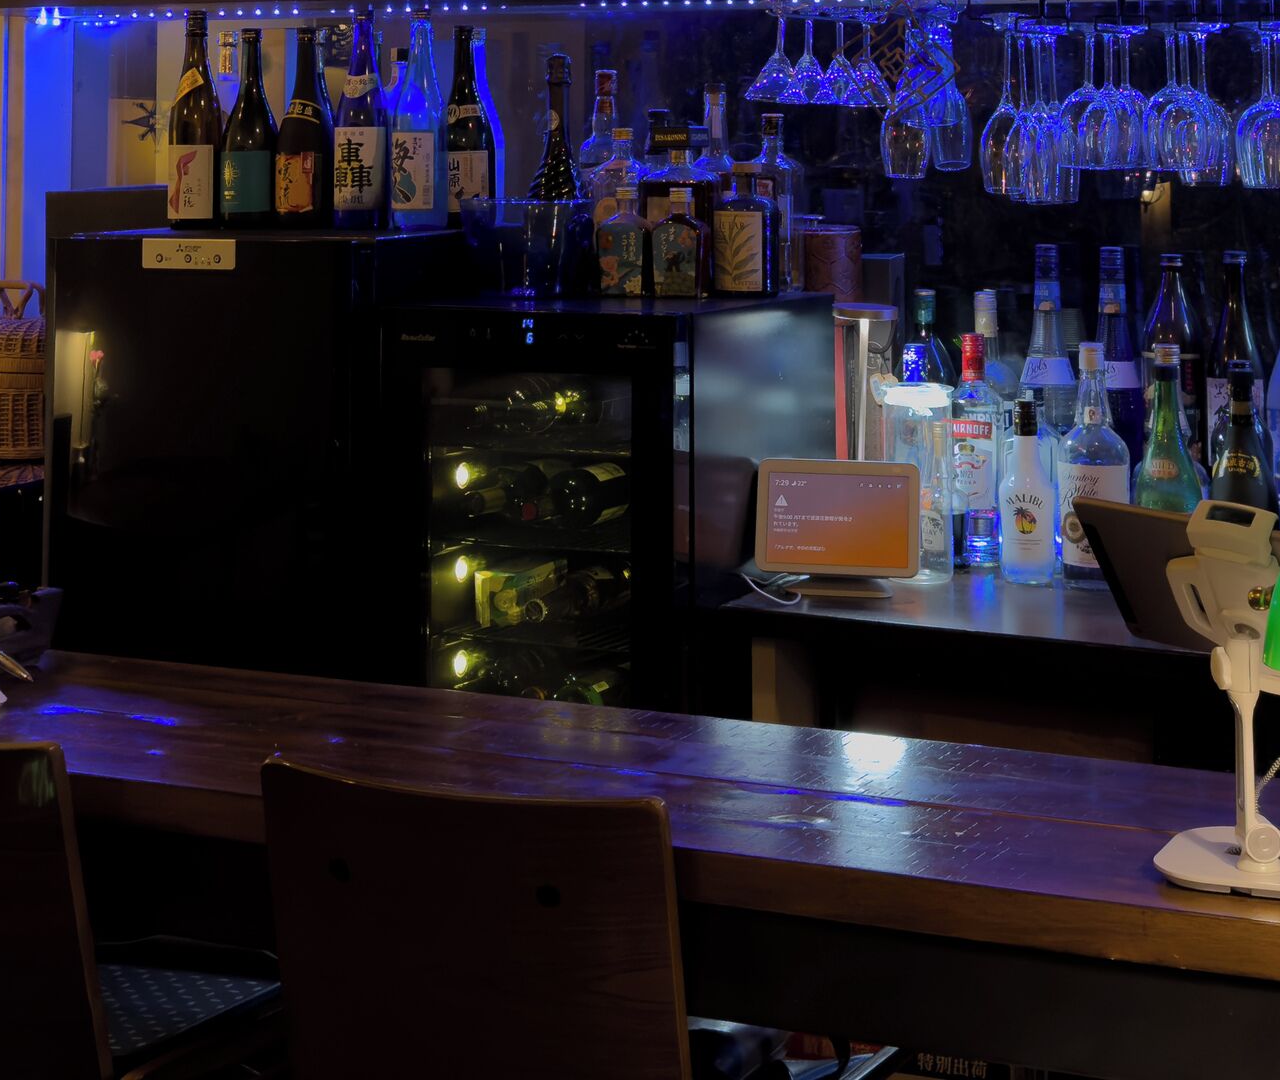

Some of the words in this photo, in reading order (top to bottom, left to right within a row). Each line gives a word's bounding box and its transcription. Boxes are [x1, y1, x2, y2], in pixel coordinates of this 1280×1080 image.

[522, 318, 534, 329] 14
[525, 332, 534, 345] 6
[1026, 361, 1048, 378] Bols
[1152, 461, 1175, 470] MILD
[775, 479, 790, 487] 7:29
[1007, 494, 1045, 510] MALIBU
[917, 1051, 989, 1080] 特別出荷
